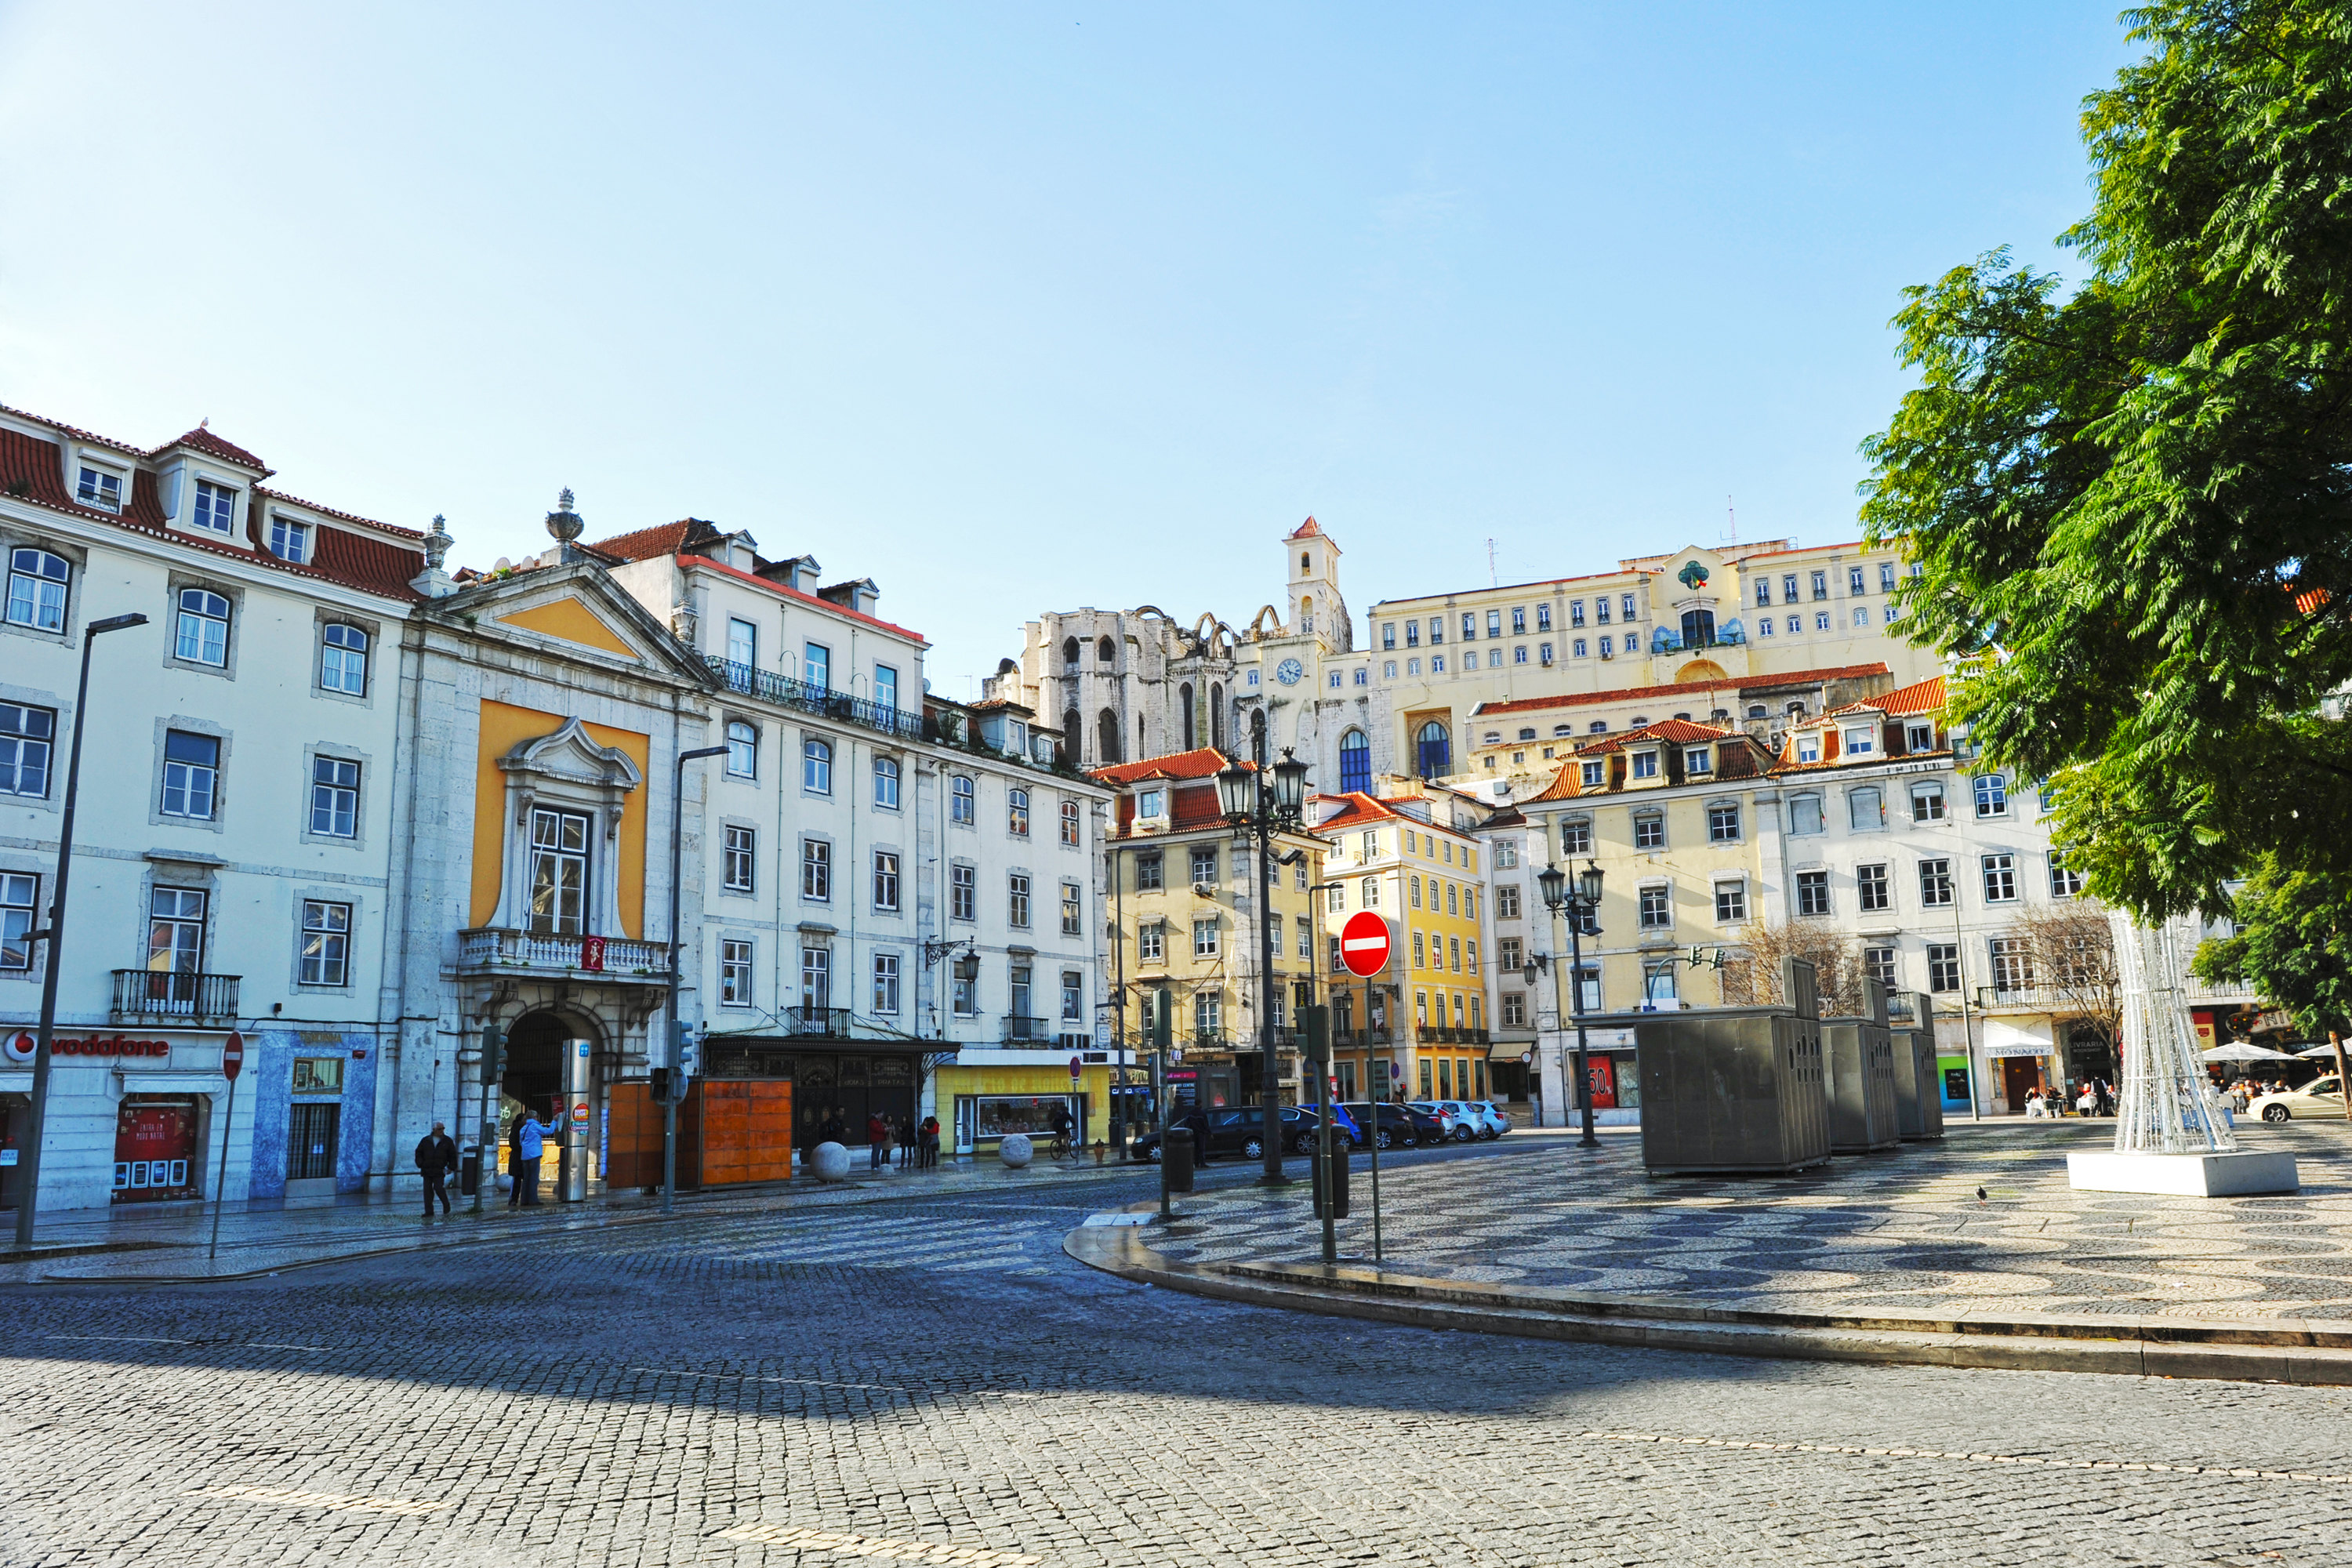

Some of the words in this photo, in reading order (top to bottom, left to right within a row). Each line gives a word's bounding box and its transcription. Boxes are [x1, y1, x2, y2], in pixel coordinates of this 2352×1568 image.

[51, 1034, 169, 1056] vodafone
[140, 1123, 154, 1132] ENTRA
[156, 1123, 163, 1131] EM
[150, 1131, 165, 1140] NATAL
